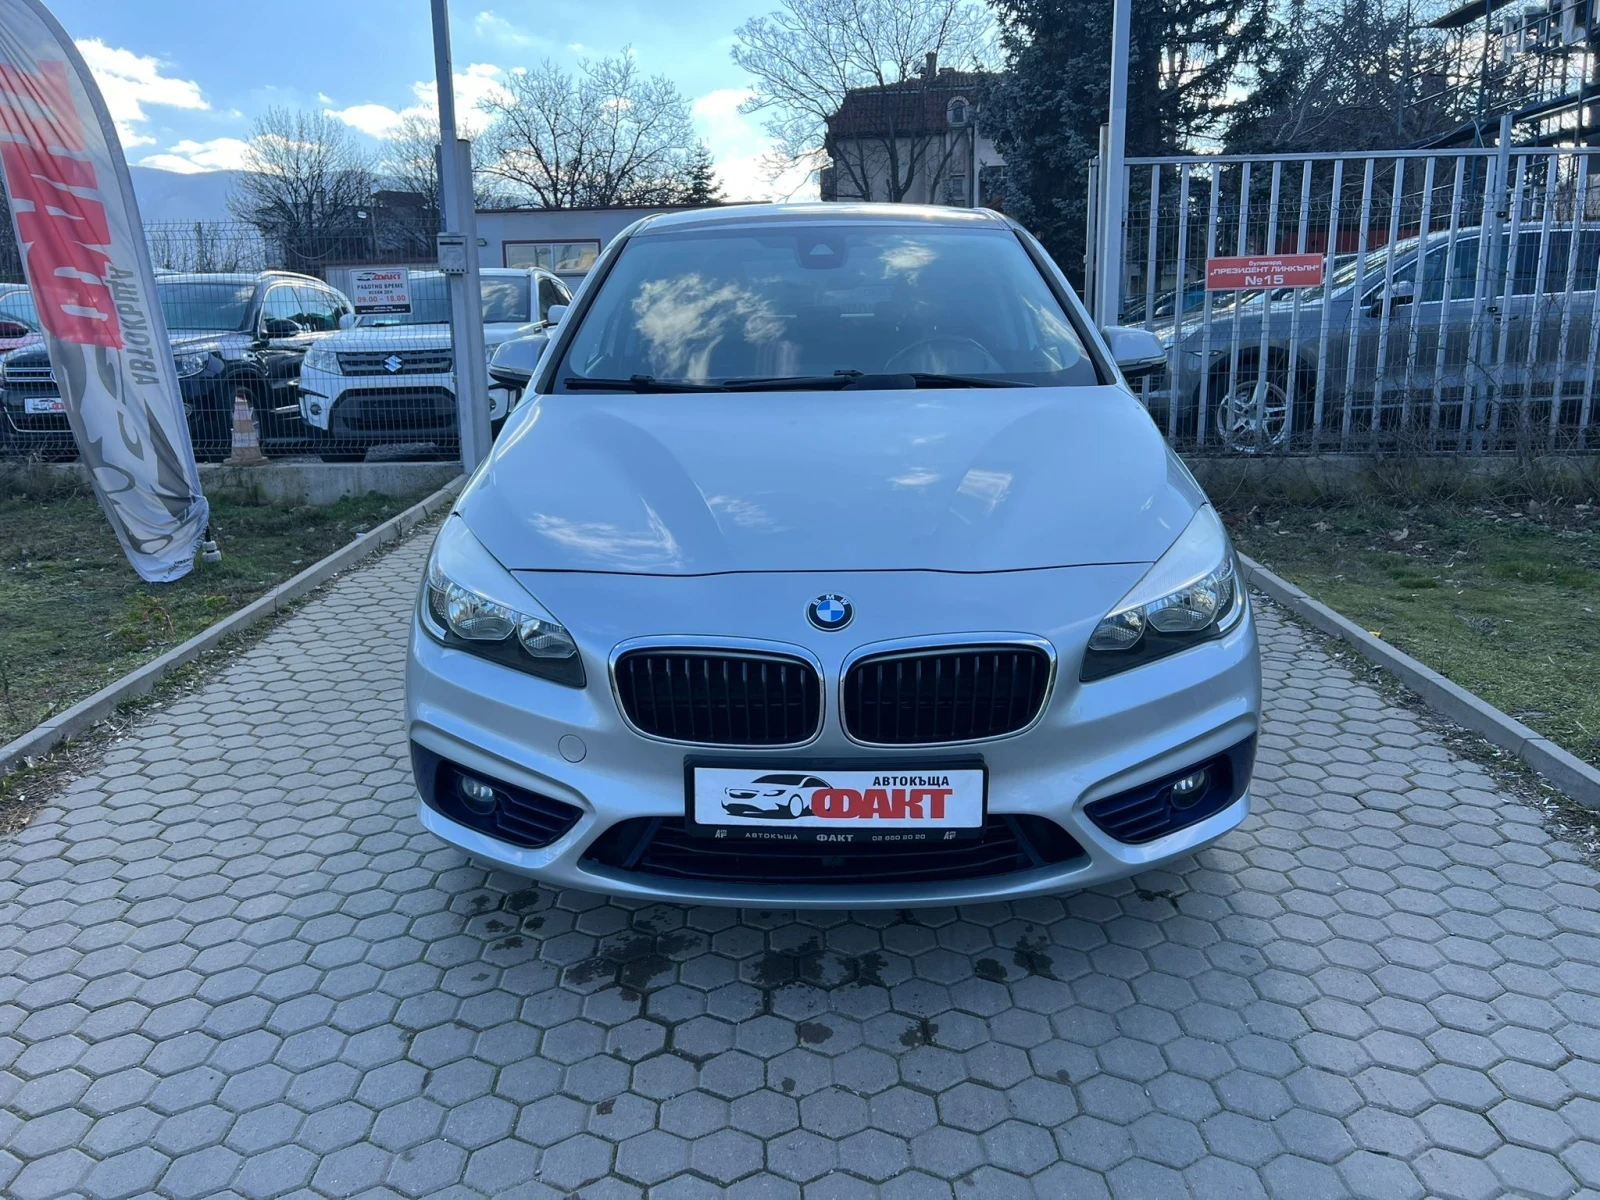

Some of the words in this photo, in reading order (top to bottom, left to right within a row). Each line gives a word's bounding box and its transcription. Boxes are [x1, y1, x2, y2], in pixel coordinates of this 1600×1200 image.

[813, 594, 849, 606] BMW
[873, 776, 949, 787] АВТОКЪЩА
[811, 789, 953, 819] ФАКТ
[816, 834, 854, 842] ФАКТ
